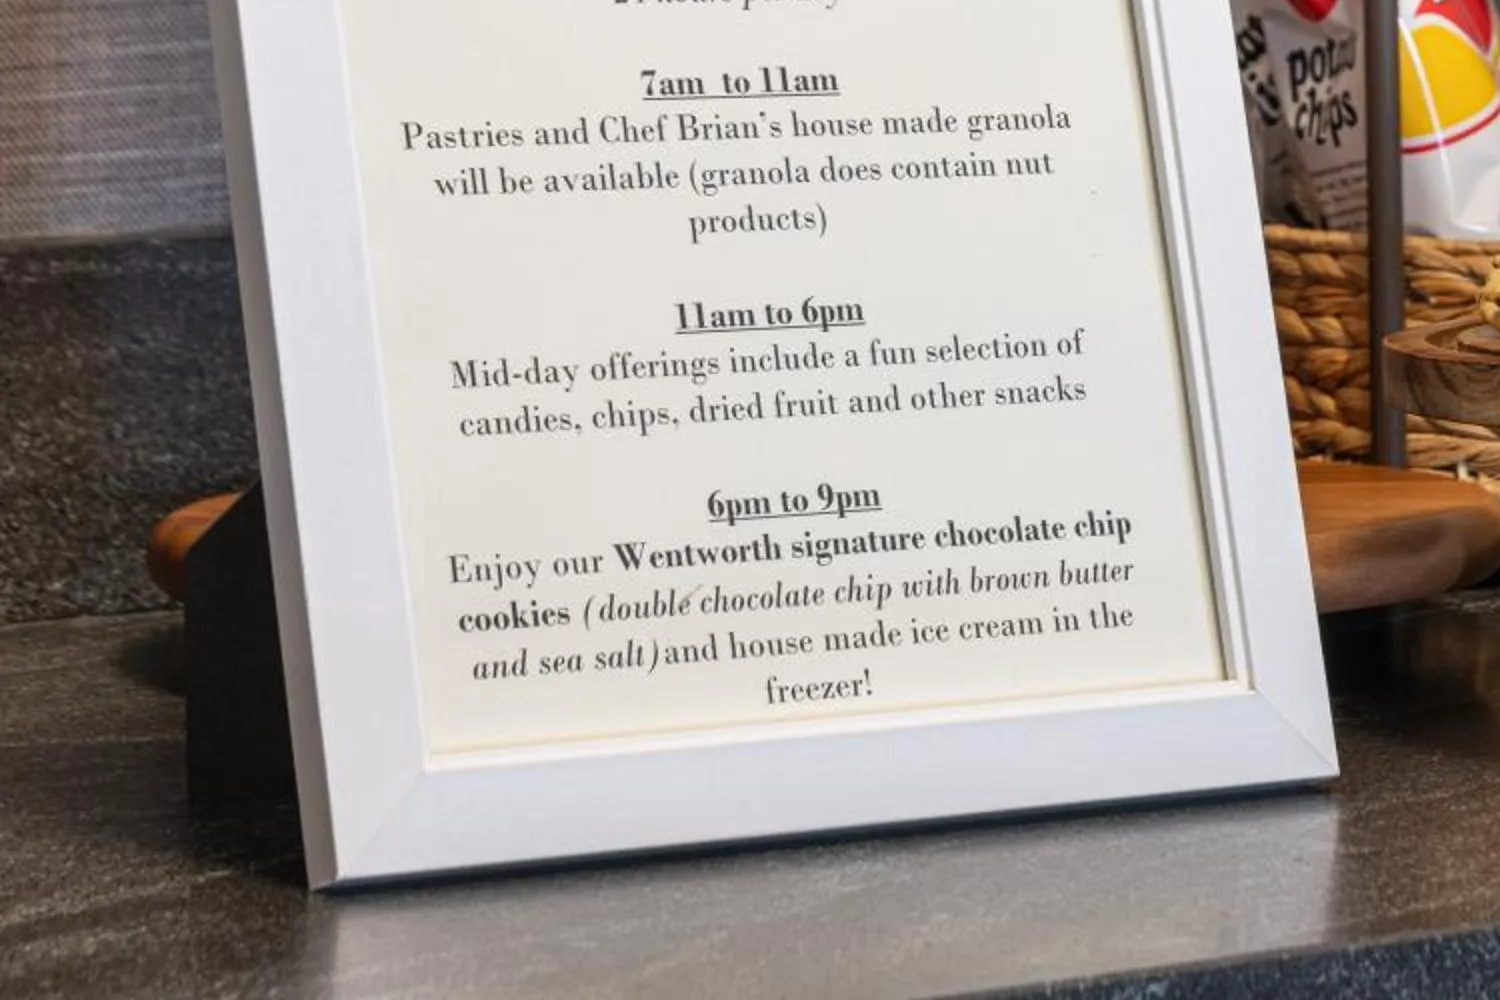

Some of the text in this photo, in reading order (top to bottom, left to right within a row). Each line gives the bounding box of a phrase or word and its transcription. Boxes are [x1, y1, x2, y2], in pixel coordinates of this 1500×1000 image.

[641, 69, 705, 98] 7am
[723, 73, 750, 94] to
[401, 103, 1071, 150] Pastries and Chef Brian's house made granola
[434, 152, 1054, 196] will be available (granola does contain nut
[689, 203, 827, 244] products)
[765, 304, 793, 325] to
[801, 296, 864, 332] 6pm
[450, 328, 1085, 392] Mid-day offerings include a fun selection of
[460, 375, 1086, 437] candies, chips, dried fruit and other snacks
[707, 482, 880, 526] 6pm to 9pm
[448, 510, 1131, 591] Enjoy our Wentworth signature chocolate chip
[459, 600, 570, 632] cookies
[700, 581, 824, 614] chocolate
[834, 574, 892, 610] chip
[902, 568, 960, 598] with
[971, 566, 1050, 593] brown
[1060, 559, 1134, 586] butter
[473, 648, 528, 680] and
[539, 654, 582, 674] sea
[728, 632, 812, 659] house
[824, 620, 902, 651] made
[912, 618, 949, 644] ice
[959, 617, 1043, 640] cream
[1053, 606, 1080, 632] in
[1089, 601, 1133, 629] the
[767, 668, 872, 704] freezer!
